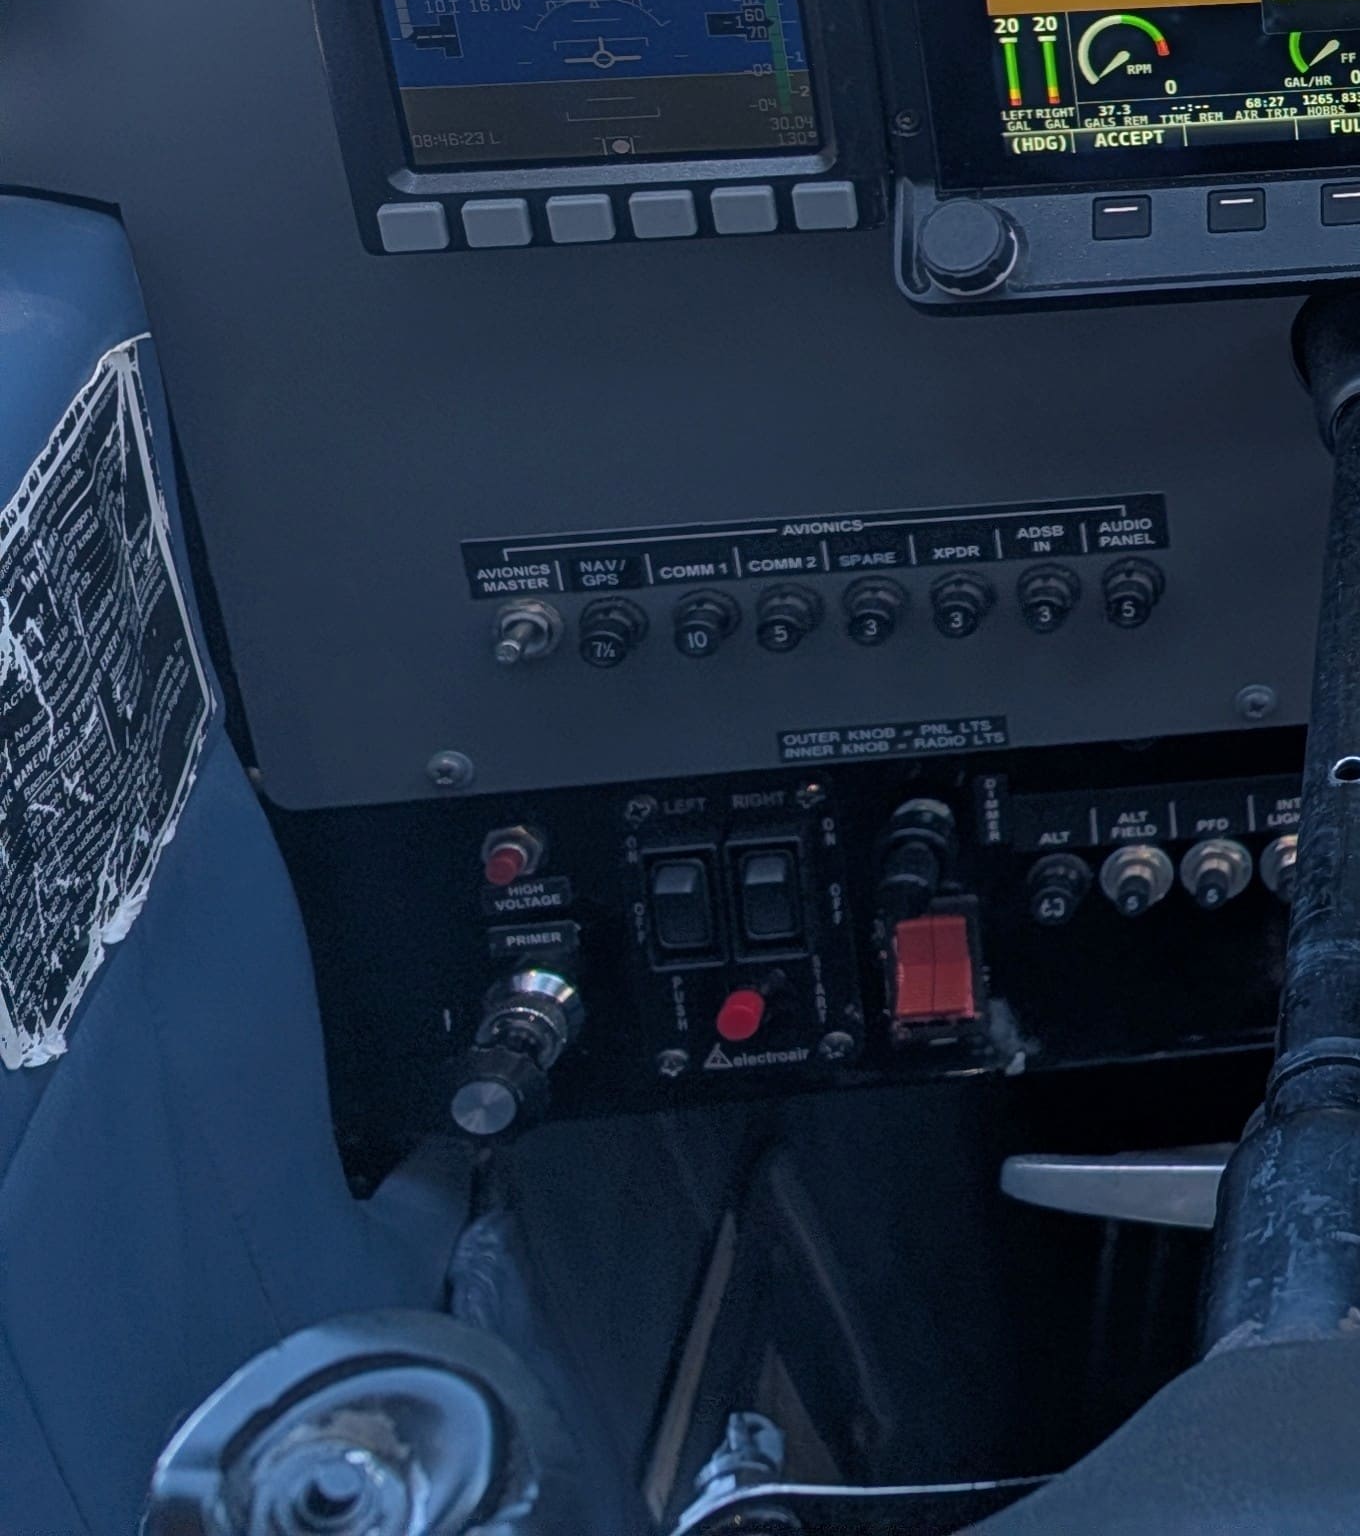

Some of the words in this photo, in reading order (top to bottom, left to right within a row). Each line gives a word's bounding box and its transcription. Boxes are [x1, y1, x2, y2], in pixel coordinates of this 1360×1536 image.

[1094, 129, 1165, 147] ACCEPT
[782, 519, 864, 535] AVIONICS
[932, 546, 981, 561] XPDR
